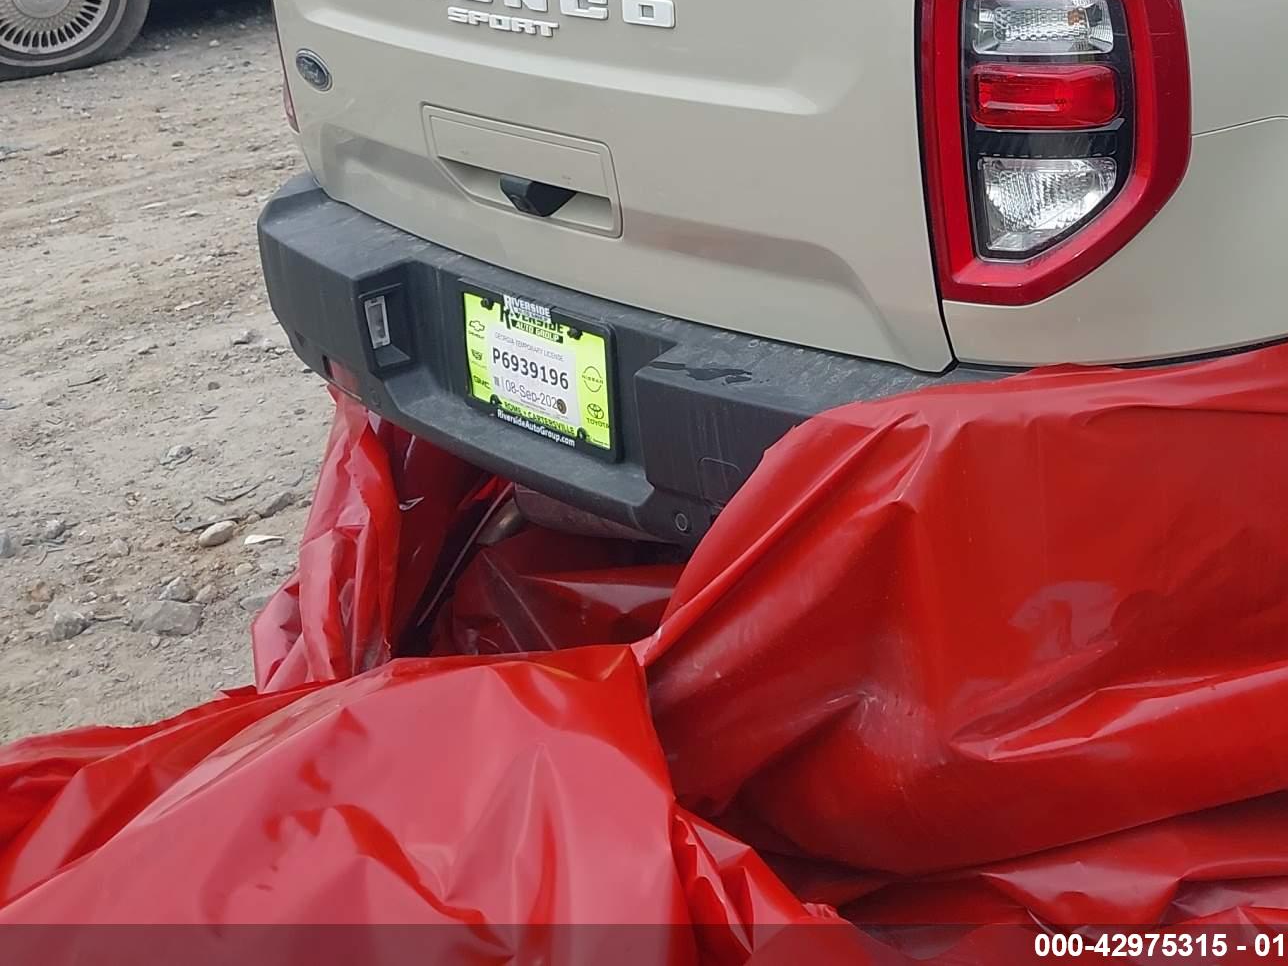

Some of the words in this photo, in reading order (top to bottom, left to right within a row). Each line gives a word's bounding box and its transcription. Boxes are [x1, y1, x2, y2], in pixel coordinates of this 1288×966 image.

[447, 6, 559, 37] SPORT
[503, 294, 551, 318] RIVERSIDE
[515, 321, 534, 334] AUTO
[492, 347, 569, 390] P6939196
[505, 378, 567, 414] 08-Sep-202
[497, 408, 576, 447] RiversideAutoGroup.com
[527, 410, 575, 435] CARTERSVILLE
